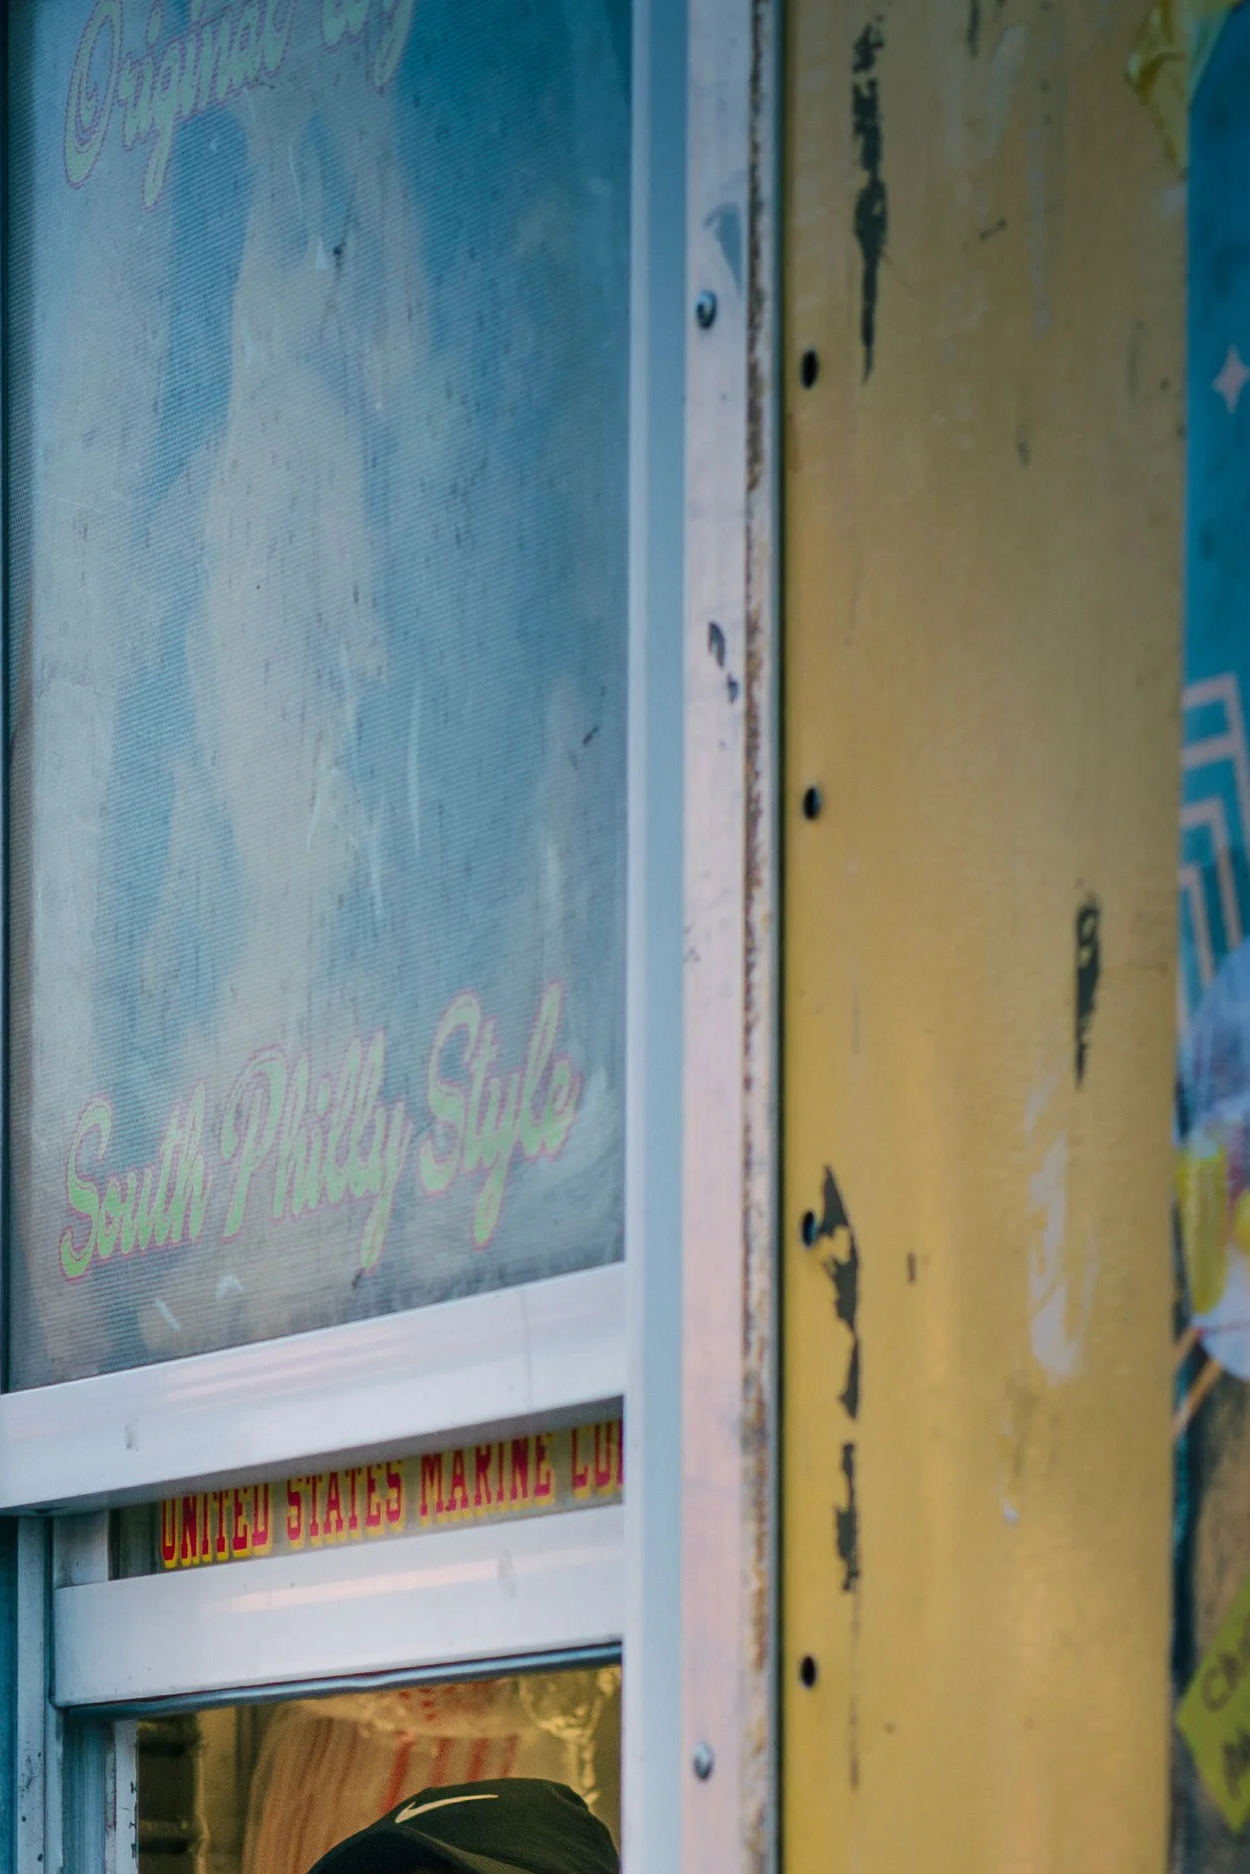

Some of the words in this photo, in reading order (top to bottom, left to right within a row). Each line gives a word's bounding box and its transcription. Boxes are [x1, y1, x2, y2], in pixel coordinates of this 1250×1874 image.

[60, 1077, 212, 1282] South
[219, 1027, 412, 1275] Philly
[419, 980, 581, 1250] Style
[161, 1482, 273, 1569] UNITED
[285, 1460, 405, 1550] STATES
[419, 1433, 556, 1529] MARINE
[570, 1418, 623, 1500] CO
